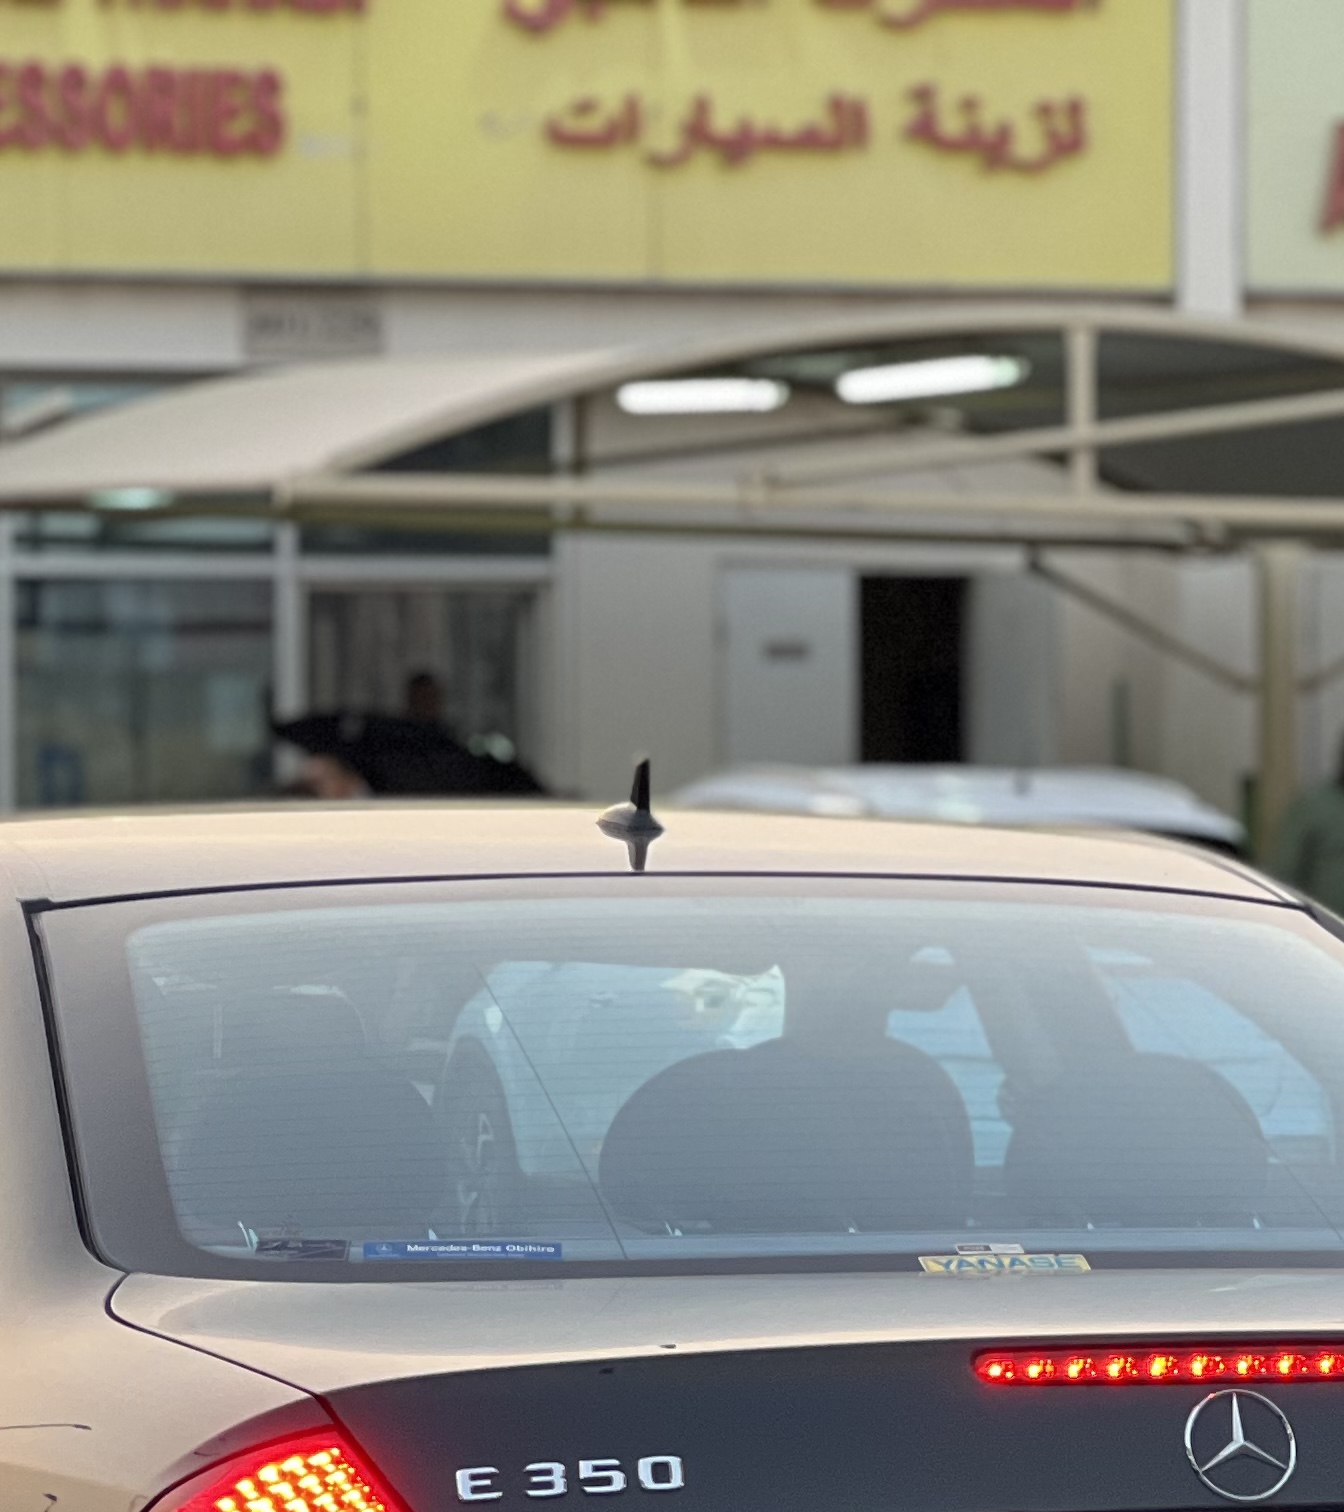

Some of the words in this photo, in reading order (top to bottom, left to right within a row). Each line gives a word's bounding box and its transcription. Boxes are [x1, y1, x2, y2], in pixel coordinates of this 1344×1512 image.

[544, 92, 870, 170] السيارات
[929, 1256, 1082, 1271] YANASE
[455, 1466, 504, 1501] E
[523, 1455, 686, 1498] 350
